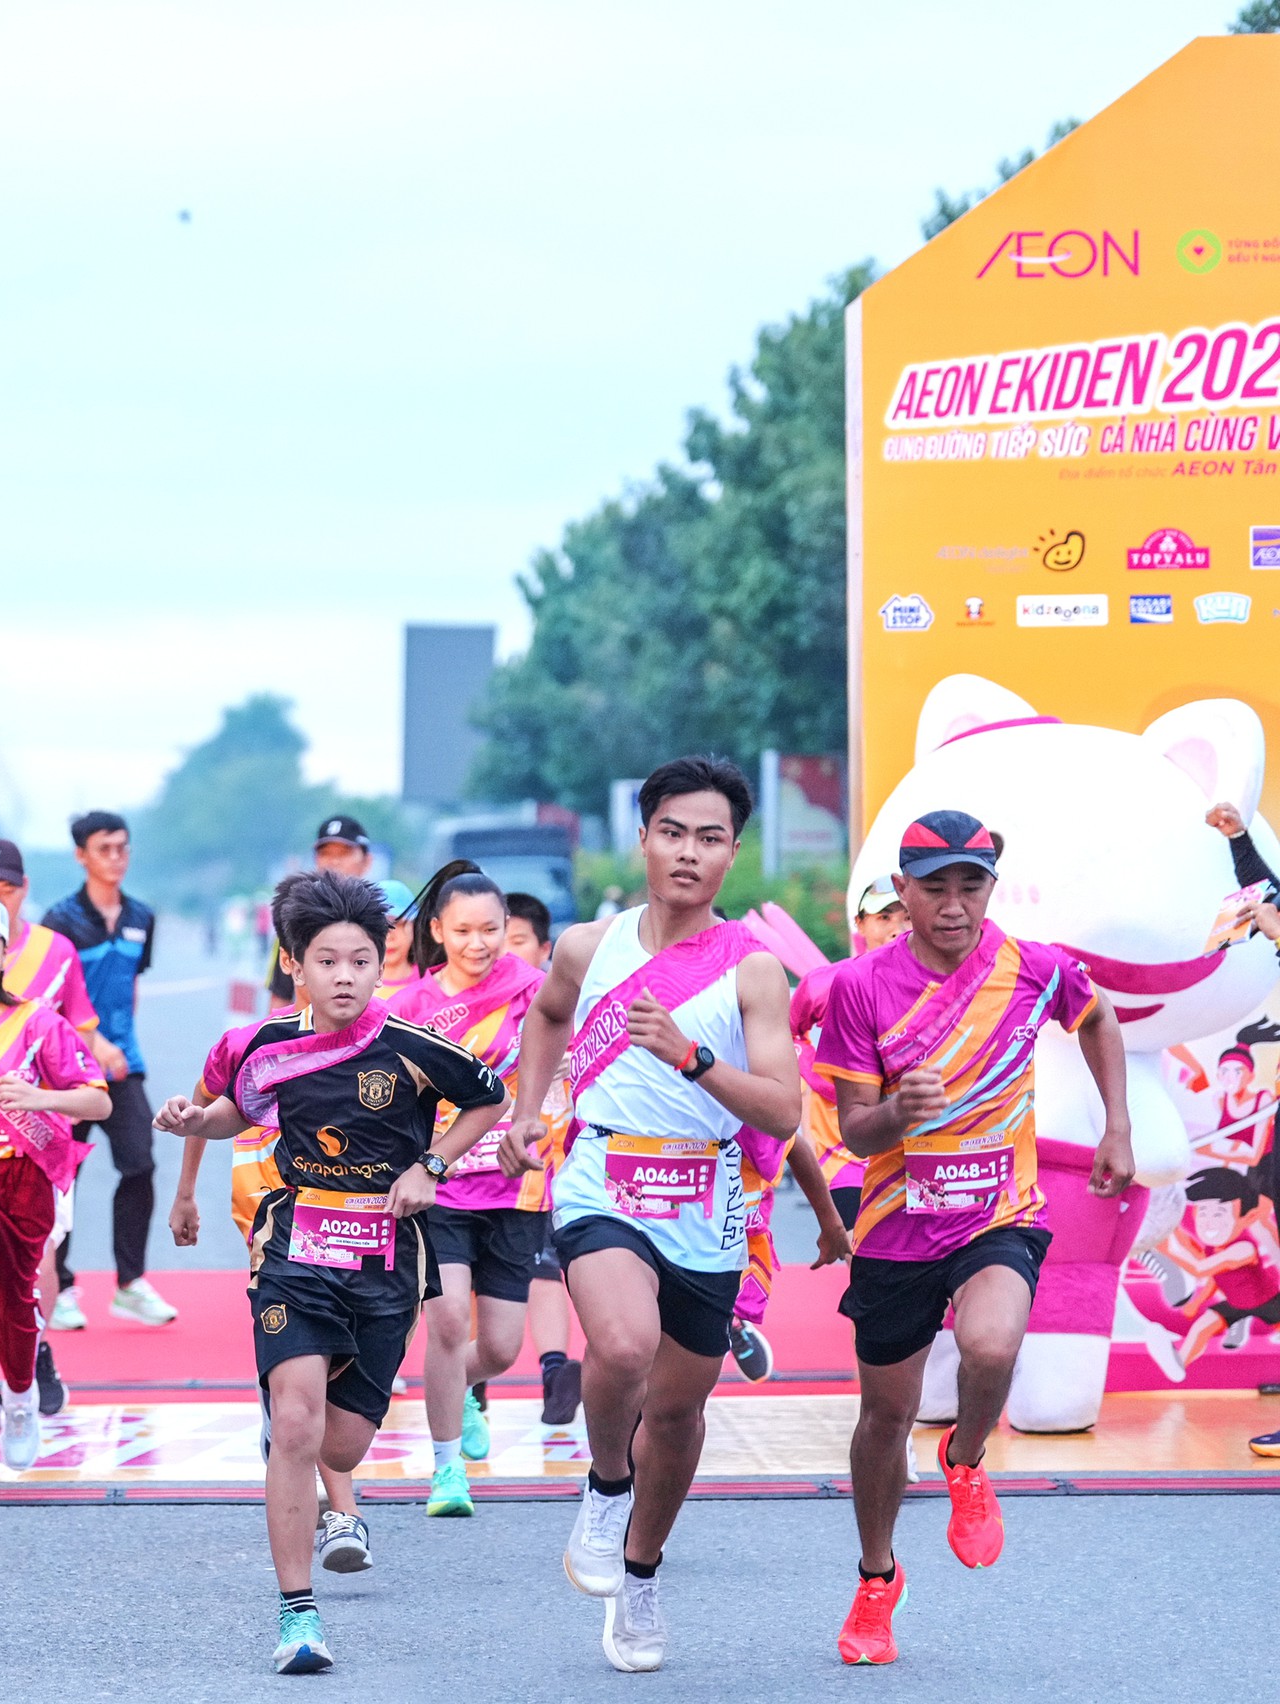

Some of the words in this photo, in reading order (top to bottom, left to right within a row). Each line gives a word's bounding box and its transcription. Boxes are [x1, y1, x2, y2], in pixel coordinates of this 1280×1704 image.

[893, 362, 988, 421] AEON
[988, 340, 1159, 414] EKIDEN
[1162, 323, 1280, 403] 202
[1131, 417, 1176, 453] NHÀ
[1184, 413, 1258, 452] CÙNG
[1172, 461, 1235, 476] AEON
[1243, 460, 1278, 475] Tân
[1131, 551, 1207, 566] TOPVALU
[892, 615, 923, 625] STOP
[589, 1001, 629, 1057] 2026
[633, 1167, 695, 1184] A046-1
[934, 1161, 996, 1180] A048-1
[319, 1219, 377, 1237] A020-1
